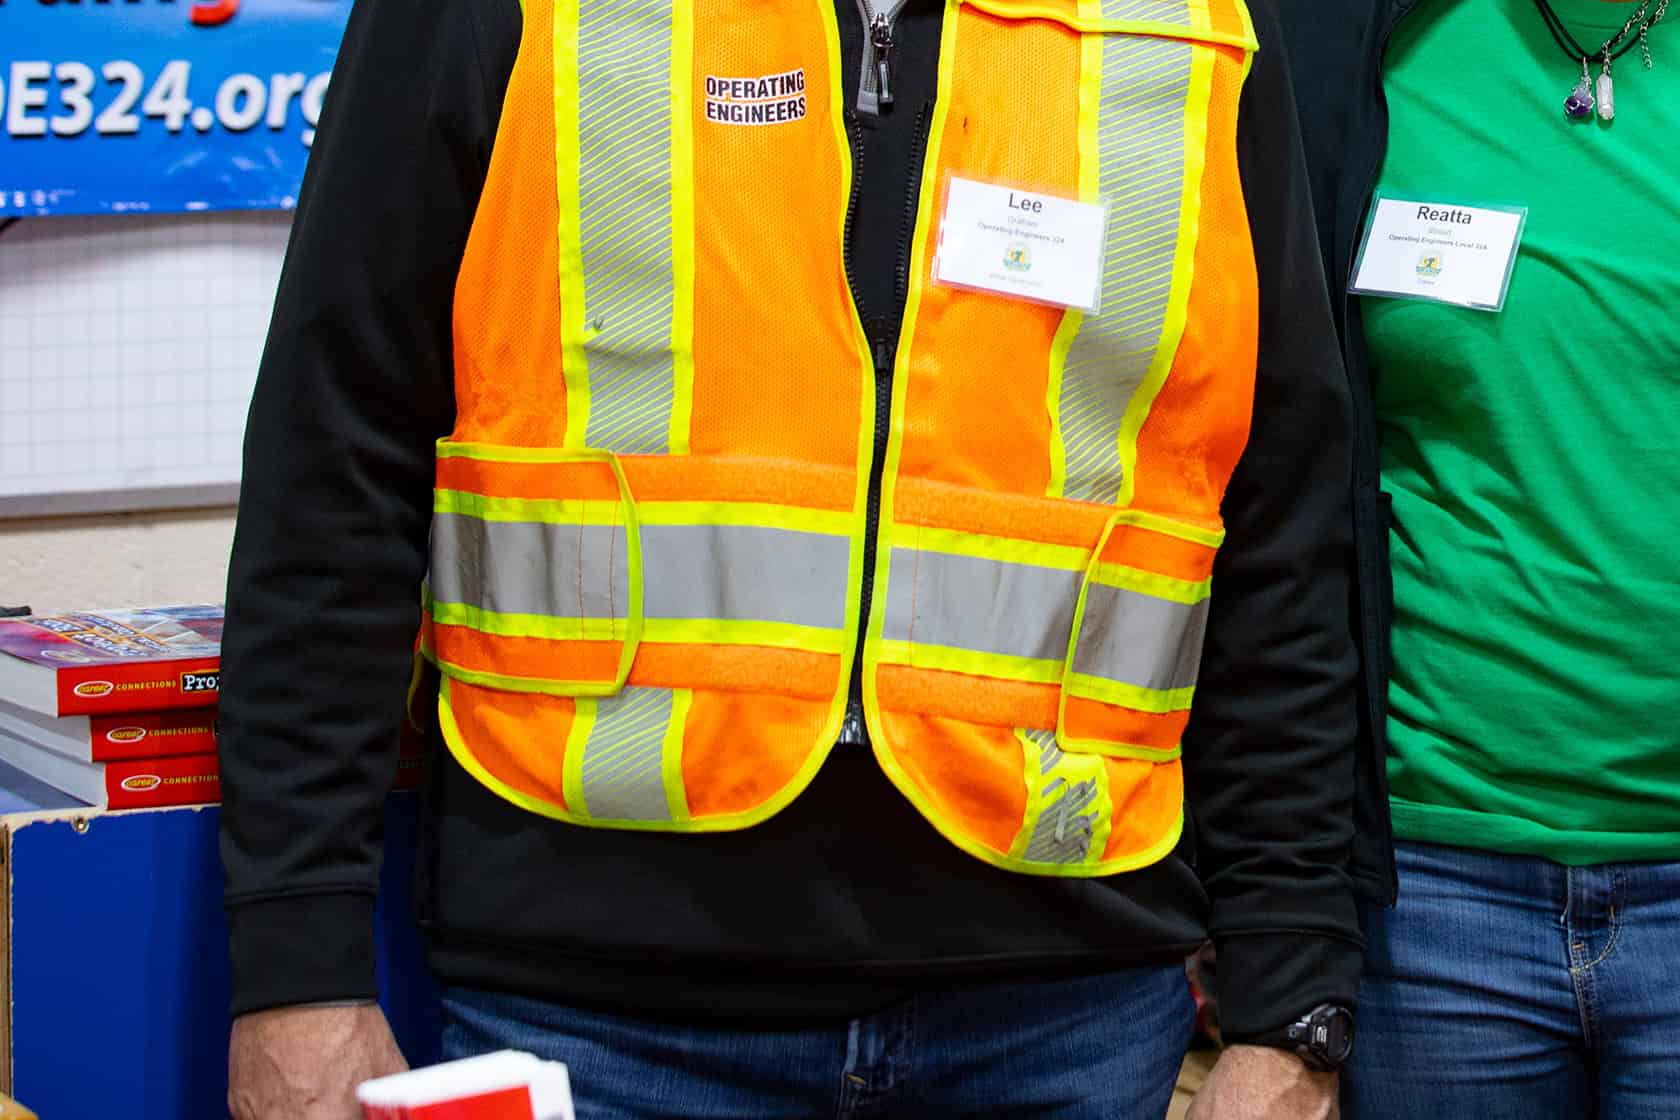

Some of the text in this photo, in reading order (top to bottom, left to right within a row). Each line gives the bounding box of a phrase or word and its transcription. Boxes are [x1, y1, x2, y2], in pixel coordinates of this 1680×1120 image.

[706, 71, 805, 98] OPERATING
[706, 97, 806, 123] ENGINEERS
[1008, 192, 1043, 213] Lee
[1416, 205, 1472, 225] Reatta
[115, 680, 177, 692] CONNECTIONS
[148, 727, 209, 737] CONNECTIONS
